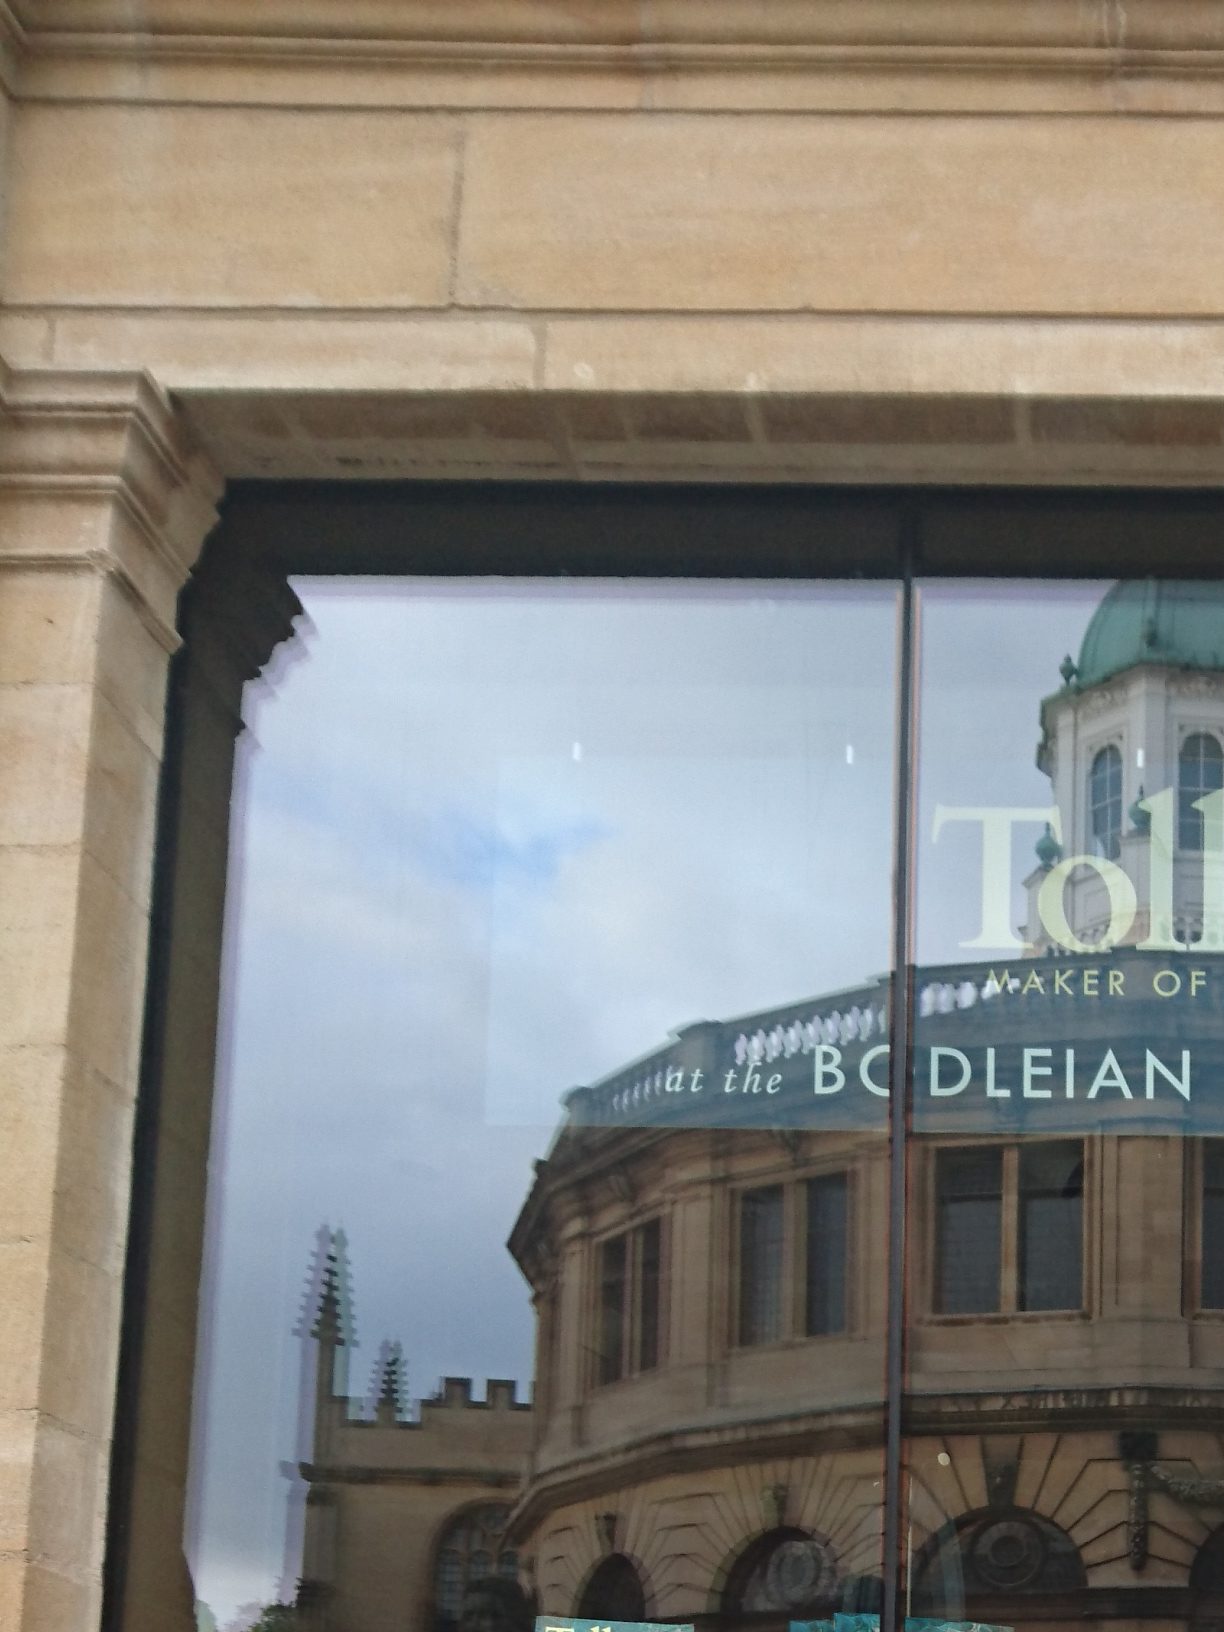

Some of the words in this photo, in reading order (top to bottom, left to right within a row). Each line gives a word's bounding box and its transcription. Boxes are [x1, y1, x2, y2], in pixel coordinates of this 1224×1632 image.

[987, 969, 1126, 997] MAKER
[1153, 970, 1206, 997] OF
[665, 1067, 703, 1094] at
[724, 1060, 782, 1094] the
